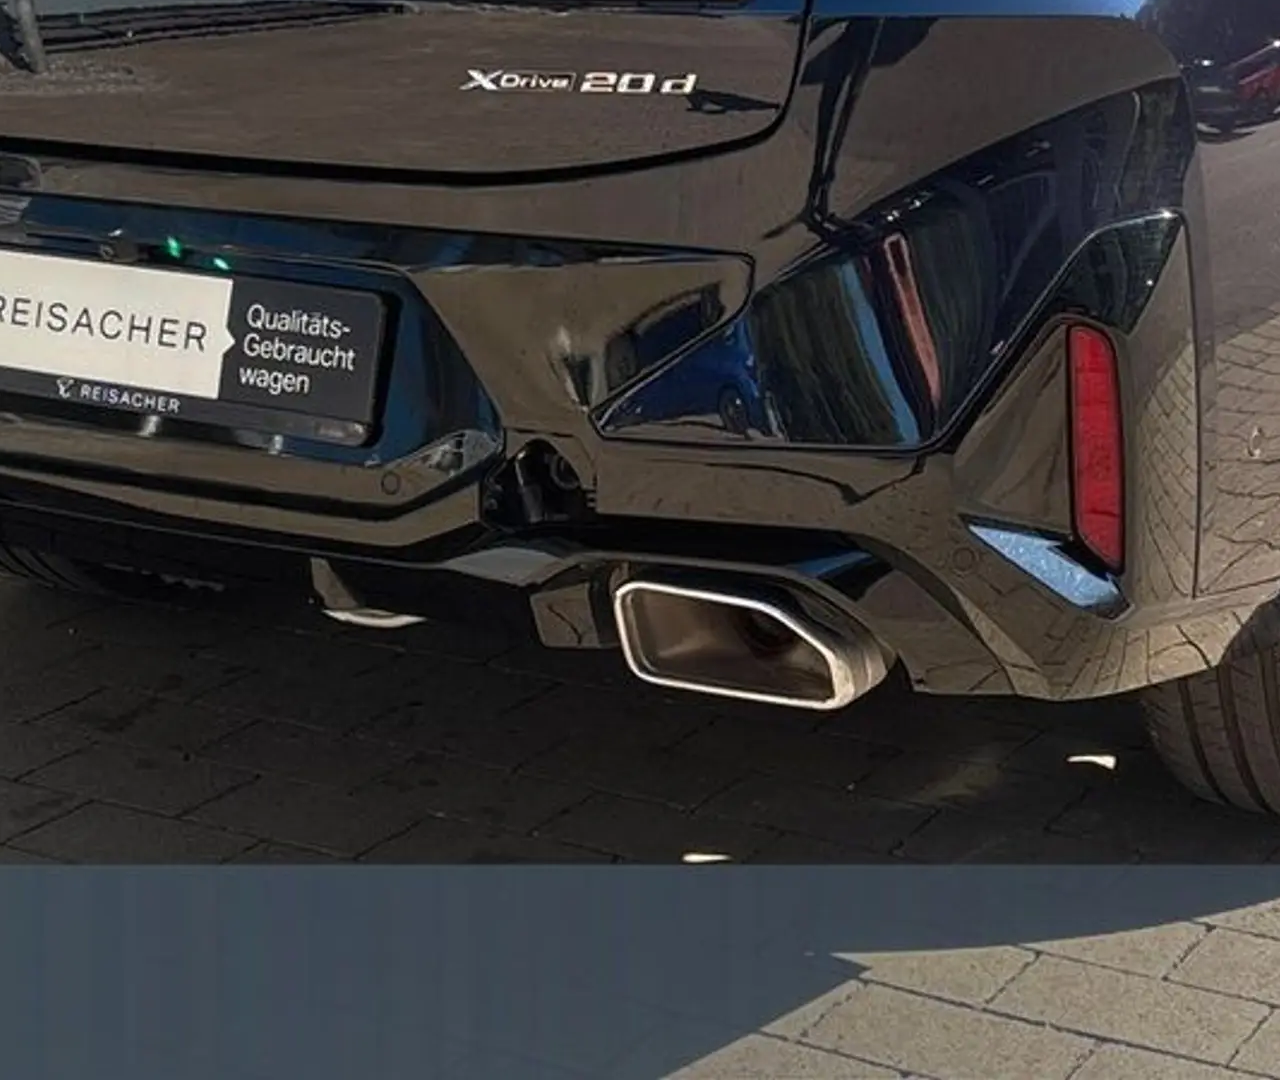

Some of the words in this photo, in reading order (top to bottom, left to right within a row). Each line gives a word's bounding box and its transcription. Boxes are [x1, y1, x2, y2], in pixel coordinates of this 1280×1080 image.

[246, 303, 352, 339] Qualitäts-
[243, 332, 356, 371] Gebraucht
[238, 366, 310, 395] wagen
[80, 383, 180, 413] REISACHER
